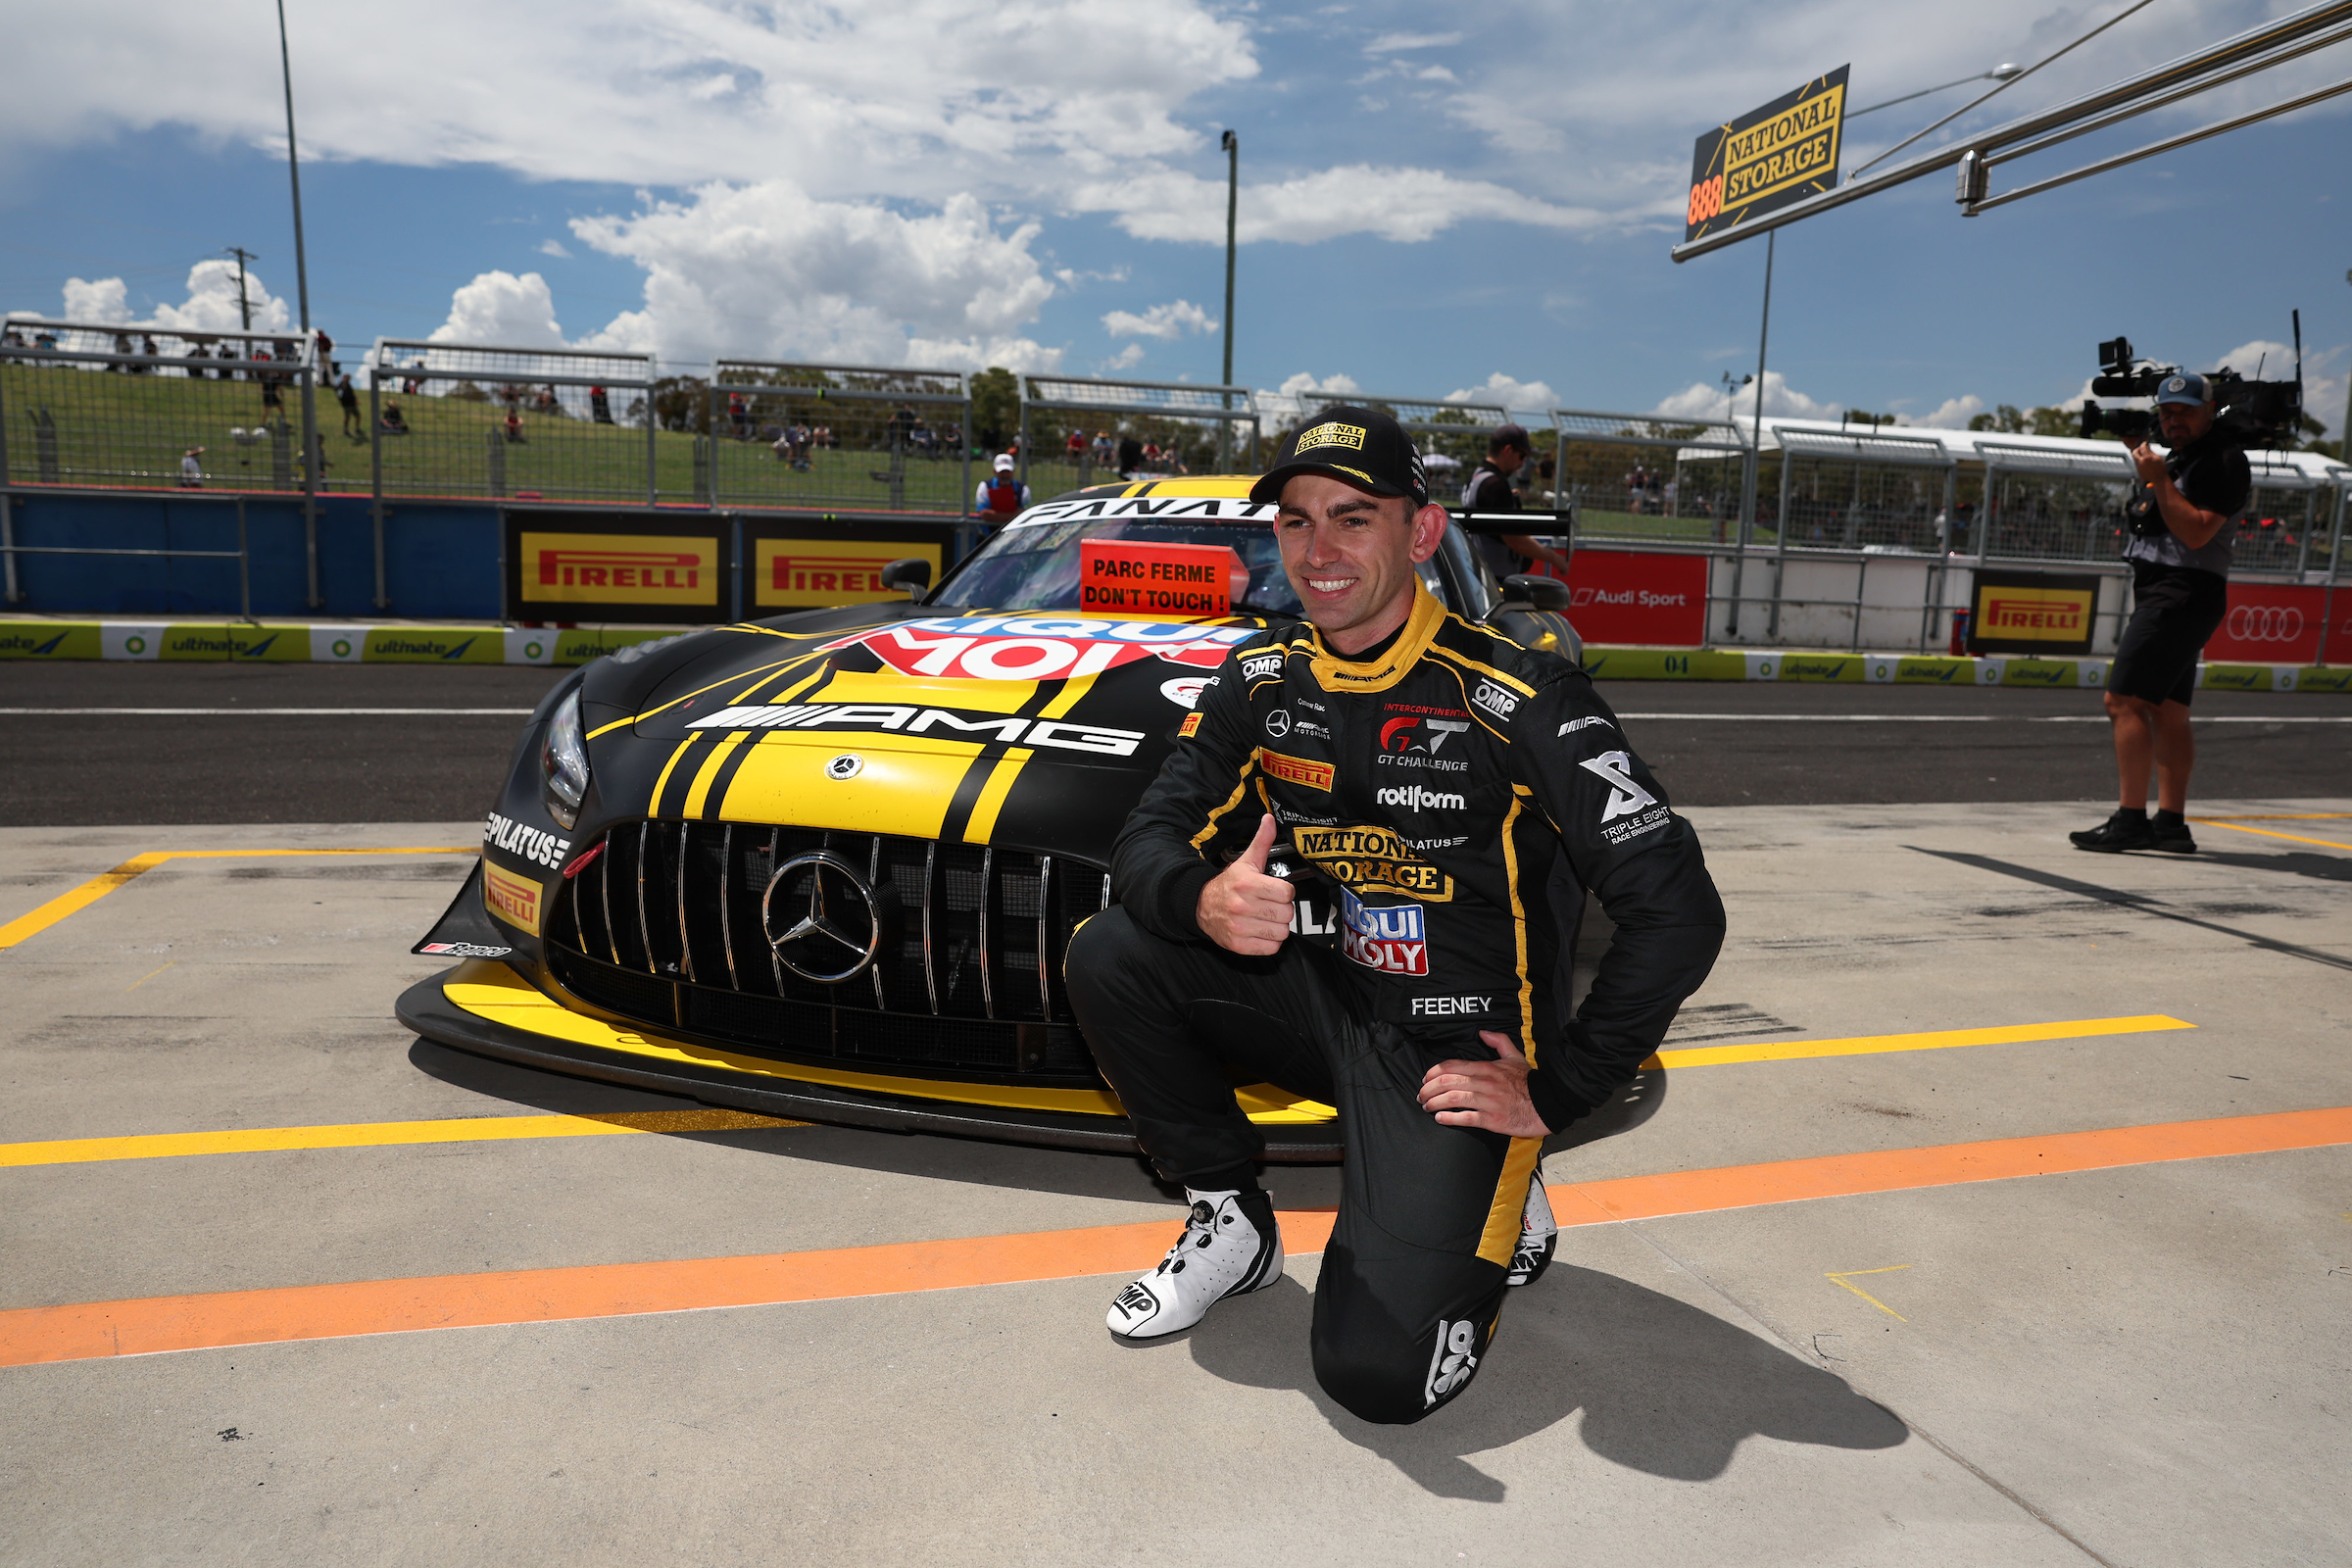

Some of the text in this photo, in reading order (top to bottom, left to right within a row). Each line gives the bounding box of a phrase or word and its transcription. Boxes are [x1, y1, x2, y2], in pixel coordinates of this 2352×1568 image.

[1729, 96, 1836, 165] NATIONAL
[1729, 134, 1828, 199] STORAGE
[1688, 174, 1723, 225] 888
[1299, 434, 1358, 450] STORAGE
[1300, 424, 1362, 441] NATIONAL
[1021, 500, 1277, 524] FANAT
[540, 550, 701, 588] PIRELLI
[772, 556, 904, 592] PIREL
[1094, 560, 1215, 583] PARC FERME
[1085, 587, 1225, 612] DON'T TOUCH !
[1594, 589, 1686, 608] Audi Sport
[1987, 599, 2082, 629] PIRELLI
[907, 617, 1254, 643] LIQUI
[172, 637, 248, 654] ultimate
[374, 638, 447, 655] ultimate
[1243, 658, 1282, 677] OMP
[1353, 664, 1396, 682] AMG
[1665, 656, 1689, 674] 04
[1785, 663, 1830, 676] ultimate
[1384, 703, 1470, 718] INTERCONTINENTAL
[1475, 684, 1516, 715] OMP
[797, 705, 1146, 757] AMG
[1263, 753, 1333, 787] PIRELLI
[1377, 755, 1468, 771] GT CHALLENGE
[1377, 785, 1465, 812] rotiform
[1600, 807, 1670, 839] TRIPLE EIGHT
[488, 813, 557, 866] PILATUS
[1400, 836, 1452, 851] ILATUS
[1611, 832, 1632, 845] RACE
[1316, 860, 1437, 890] TORAGE
[487, 871, 536, 923] PIRELLI
[1344, 893, 1418, 939] LIQUI
[1344, 924, 1423, 971] MOLY
[1411, 997, 1493, 1015] FEENEY
